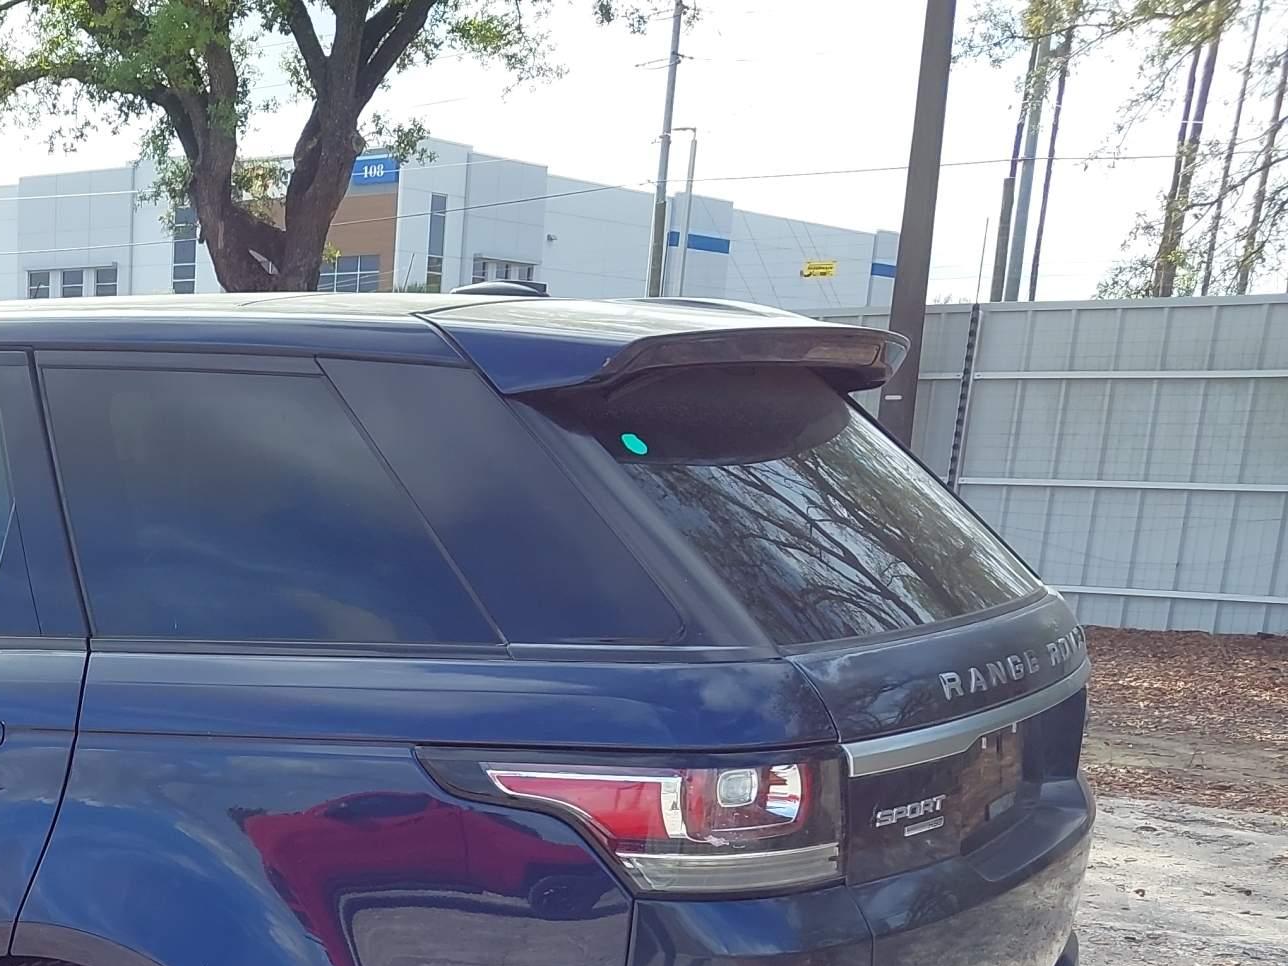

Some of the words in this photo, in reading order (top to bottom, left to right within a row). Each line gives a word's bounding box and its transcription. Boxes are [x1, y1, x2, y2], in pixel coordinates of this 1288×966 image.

[362, 163, 384, 178] 108
[938, 649, 1040, 701] RANGE
[876, 794, 946, 828] SPORT
